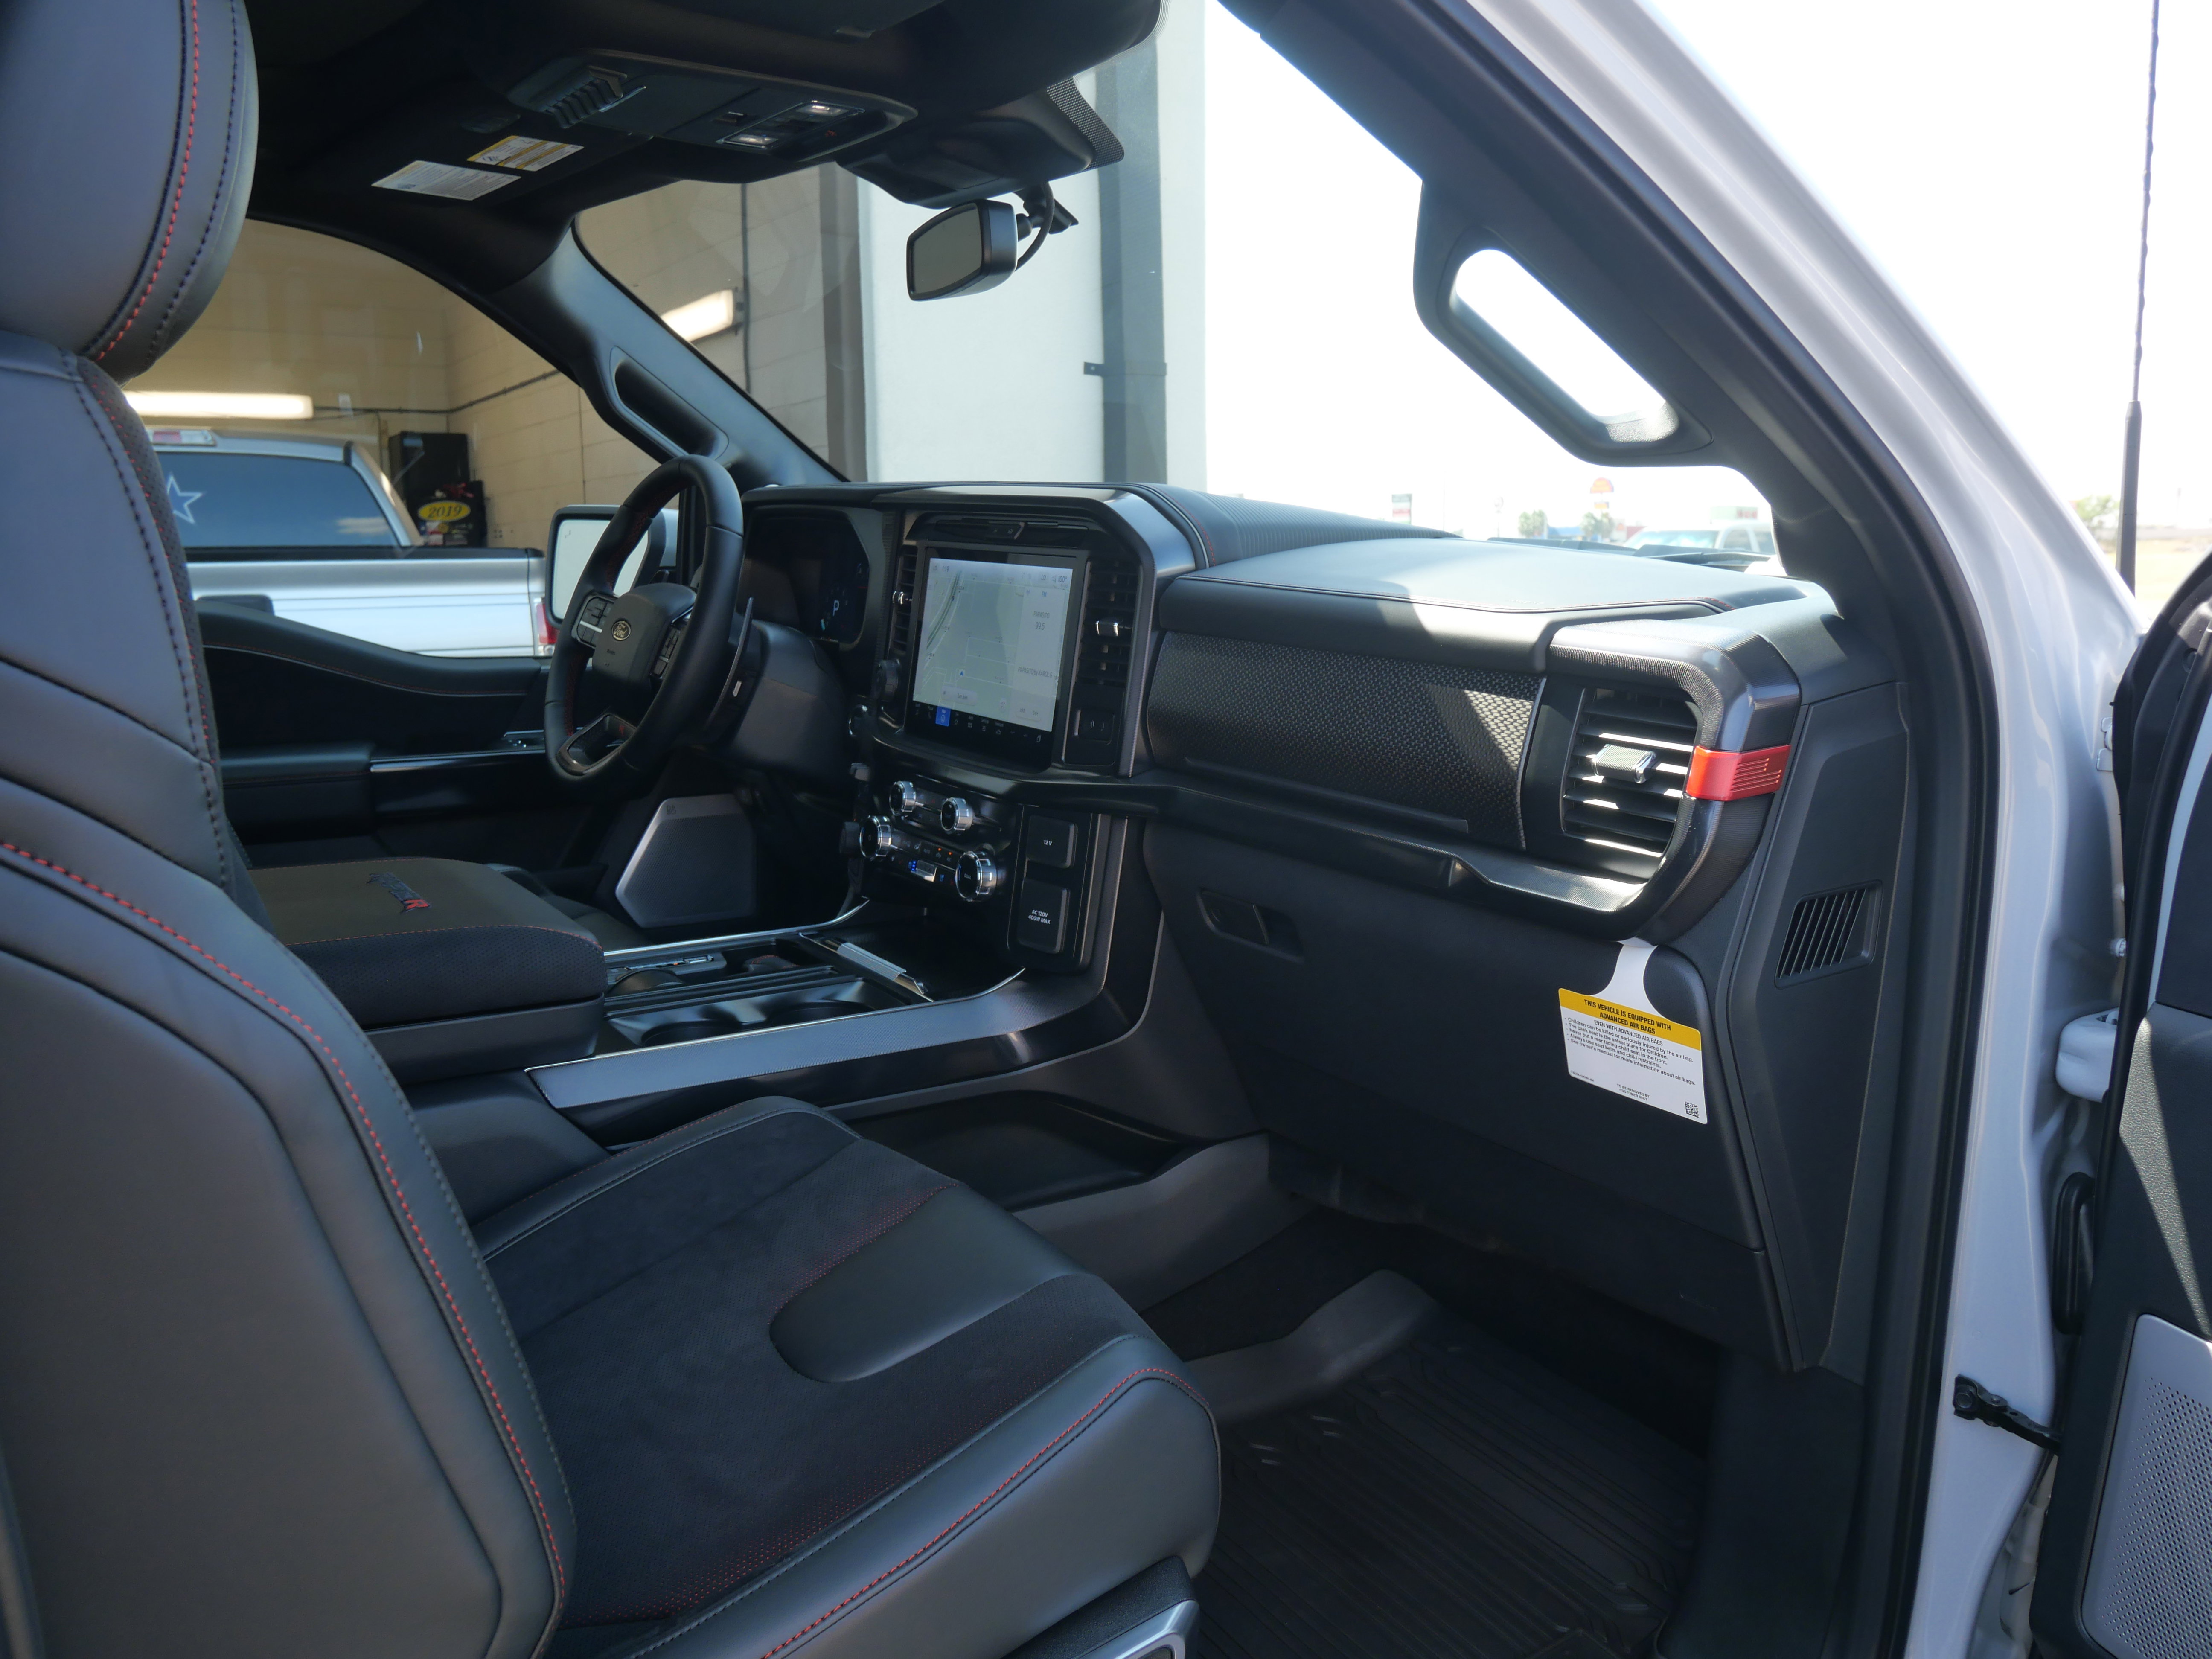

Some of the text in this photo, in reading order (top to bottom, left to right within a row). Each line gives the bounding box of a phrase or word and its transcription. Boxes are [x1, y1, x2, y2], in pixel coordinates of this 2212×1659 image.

[427, 505, 463, 518] 2019
[833, 600, 840, 617] P
[1584, 999, 1596, 1008] THIS
[1598, 1004, 1619, 1015] VEHICLE
[1628, 1013, 1655, 1025] EQUIPPED
[1656, 1021, 1671, 1031] WITH
[1600, 1012, 1628, 1025] ADVANCED
[1641, 1025, 1655, 1034] BAGS
[1568, 1017, 1586, 1027] Children
[1621, 1036, 1642, 1046] seriously
[1643, 1042, 1659, 1051] injured
[1618, 1028, 1641, 1039] ADVANCED
[1570, 1033, 1585, 1042] Always
[1638, 1057, 1662, 1068] restraints.
[1604, 1040, 1617, 1048] facing
[1612, 1037, 1625, 1045] safest
[1647, 1049, 1668, 1059] Children.
[1579, 1042, 1596, 1051] owner's
[1597, 1048, 1613, 1057] manual
[1633, 1060, 1659, 1073] information
[1682, 1077, 1696, 1085] bags.
[1619, 1088, 1638, 1098] CUSTOMER
[1627, 1087, 1644, 1096] REMOVED
